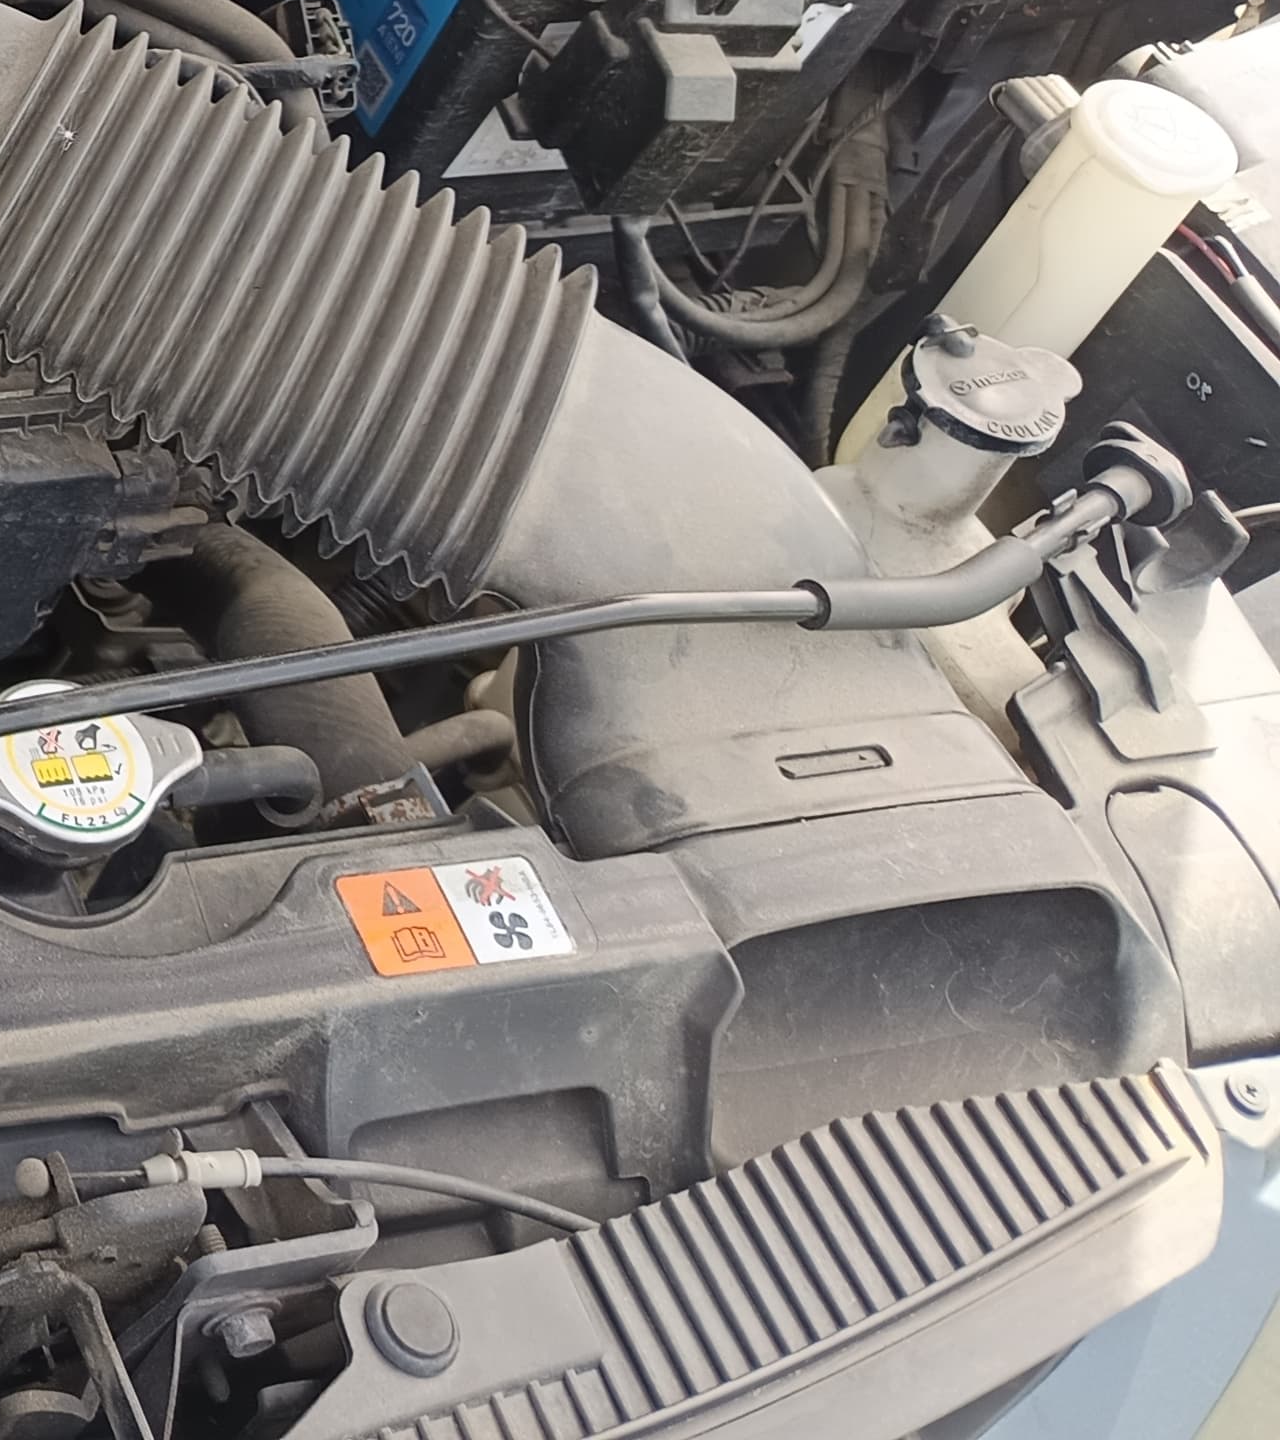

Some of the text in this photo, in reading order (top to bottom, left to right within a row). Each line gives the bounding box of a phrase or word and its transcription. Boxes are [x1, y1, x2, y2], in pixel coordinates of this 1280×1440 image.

[386, 0, 417, 47] 720
[987, 410, 1060, 439] COOLANT
[61, 812, 110, 827] FL22
